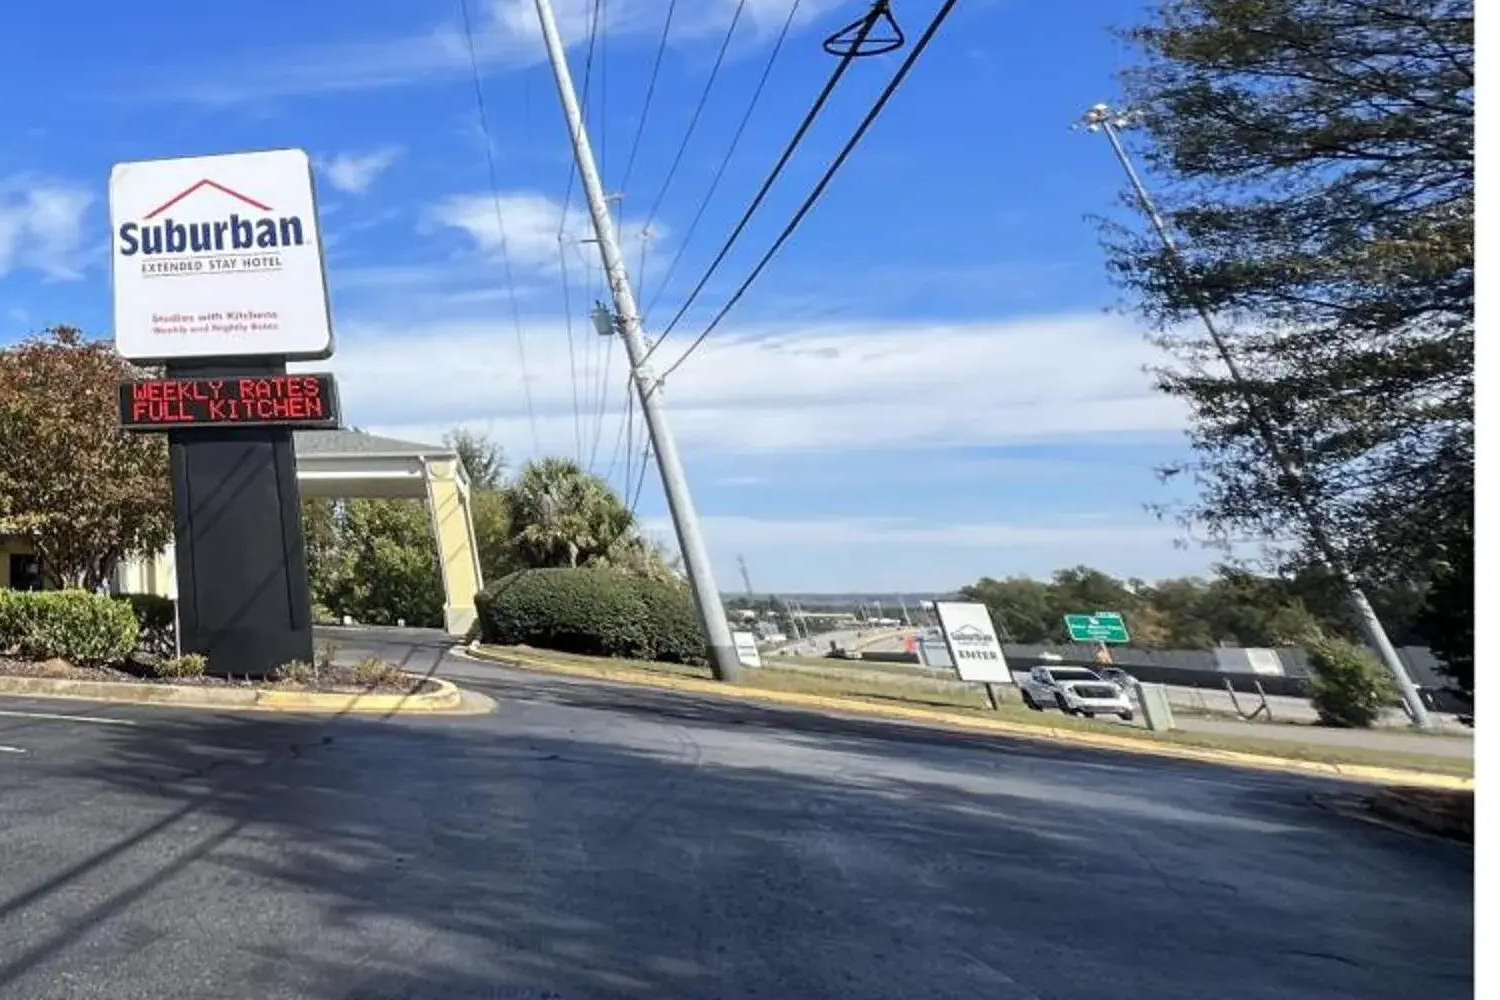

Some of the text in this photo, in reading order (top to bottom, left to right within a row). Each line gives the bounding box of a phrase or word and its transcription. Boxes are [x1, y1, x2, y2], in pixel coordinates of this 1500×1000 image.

[119, 214, 304, 256] Suburban
[141, 256, 283, 273] EXTENDED STAY HOTEL
[133, 377, 319, 400] WEEKLY RATES
[133, 398, 323, 421] FULL KITCHEN
[958, 650, 997, 660] ENTER
